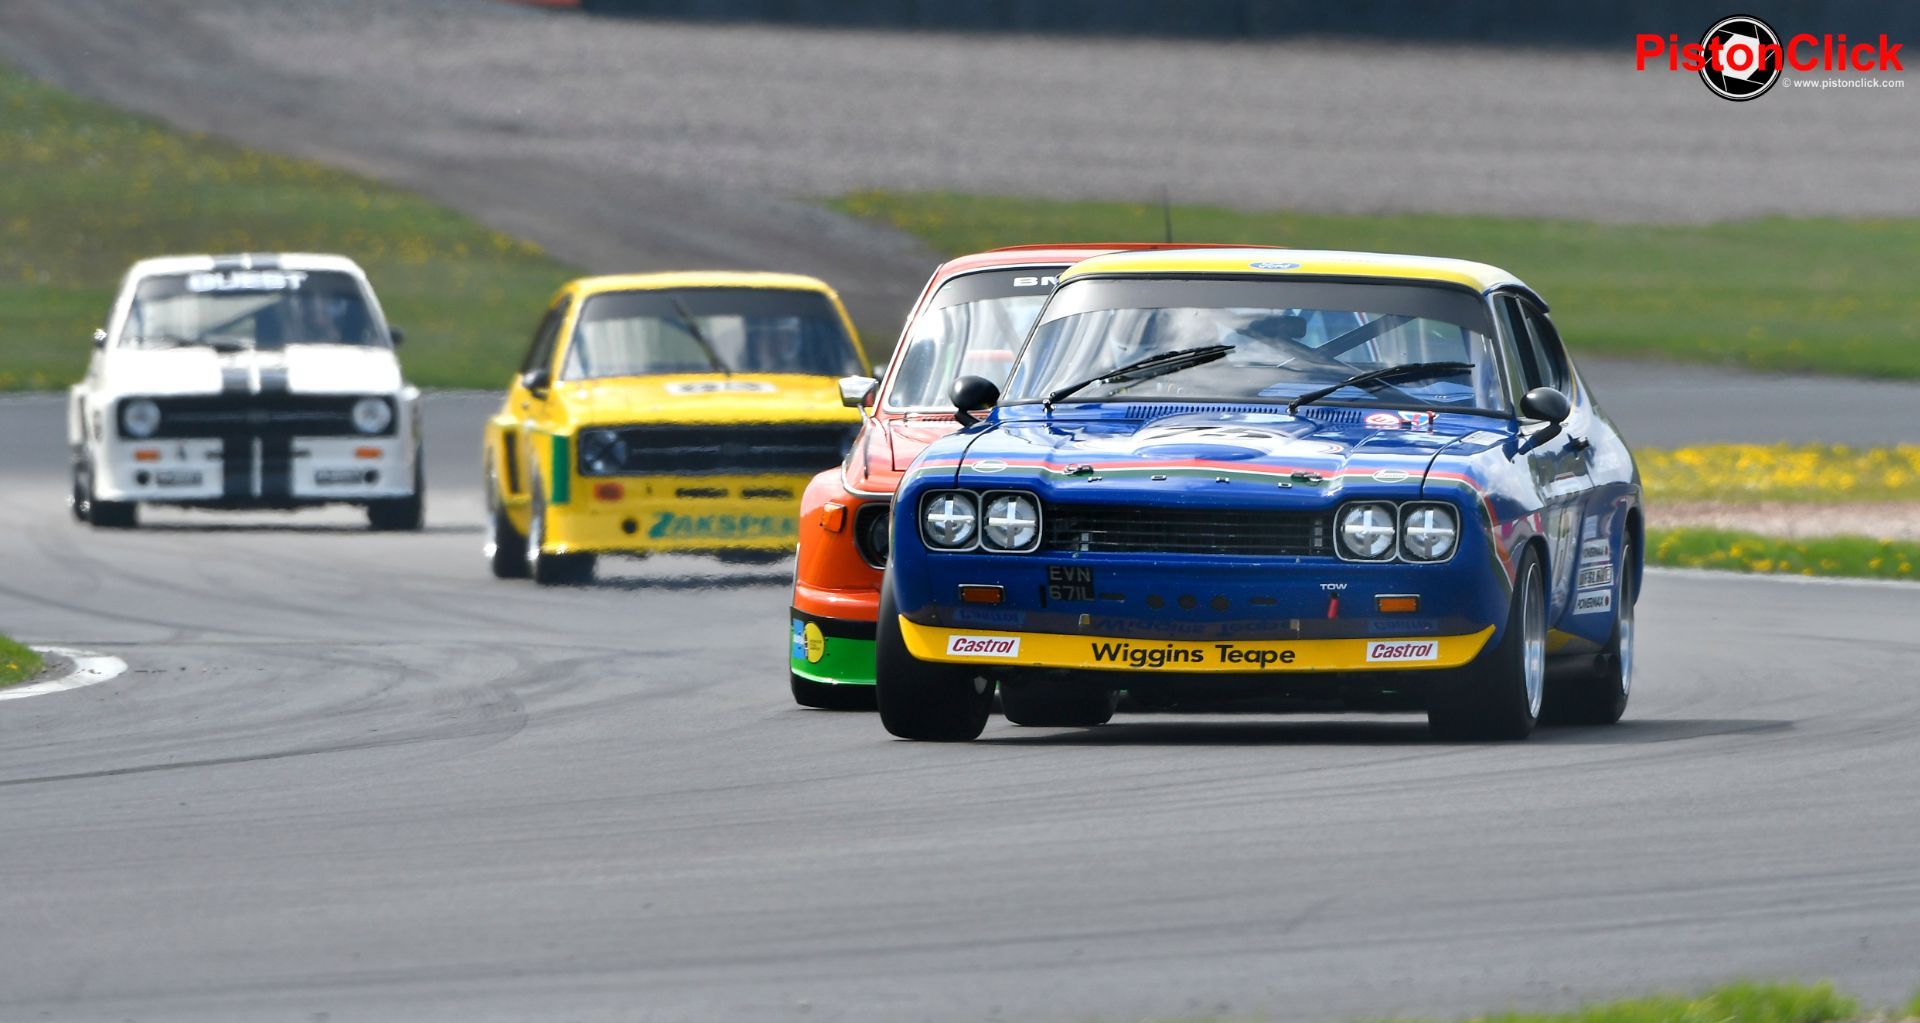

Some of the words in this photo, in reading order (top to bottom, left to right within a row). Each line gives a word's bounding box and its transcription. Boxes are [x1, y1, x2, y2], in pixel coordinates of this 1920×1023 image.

[1050, 565, 1091, 582] EVN
[952, 638, 1016, 653] Castrol
[1371, 643, 1434, 659] Castrol
[1091, 643, 1204, 668] Wiggins
[1215, 644, 1296, 668] Teape
